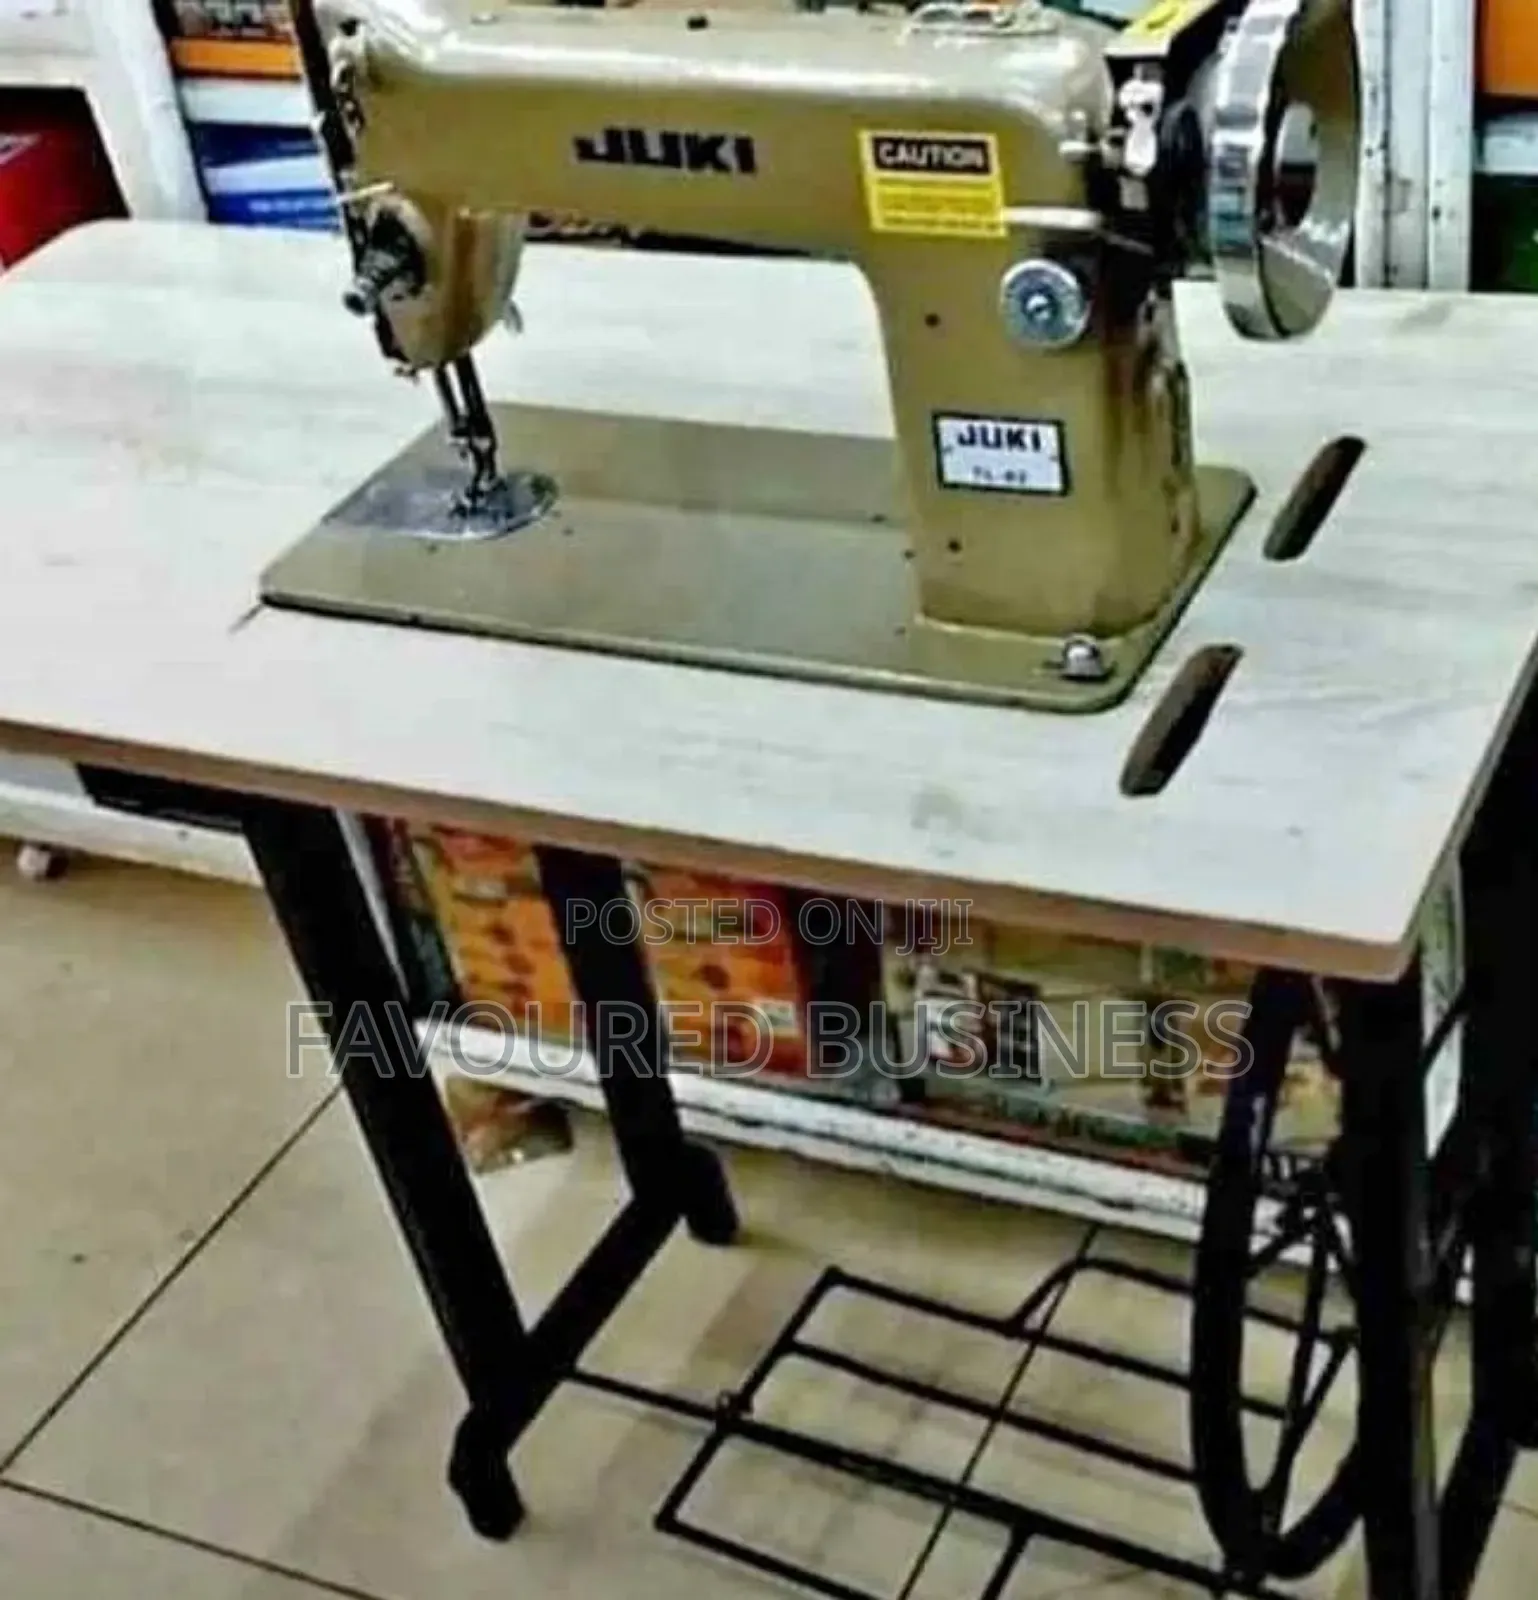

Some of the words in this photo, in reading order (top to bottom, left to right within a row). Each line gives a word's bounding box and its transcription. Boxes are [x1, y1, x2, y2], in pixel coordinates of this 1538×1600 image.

[573, 127, 756, 174] JUKI
[878, 141, 984, 168] CAUTION
[957, 424, 1041, 452] JUKI
